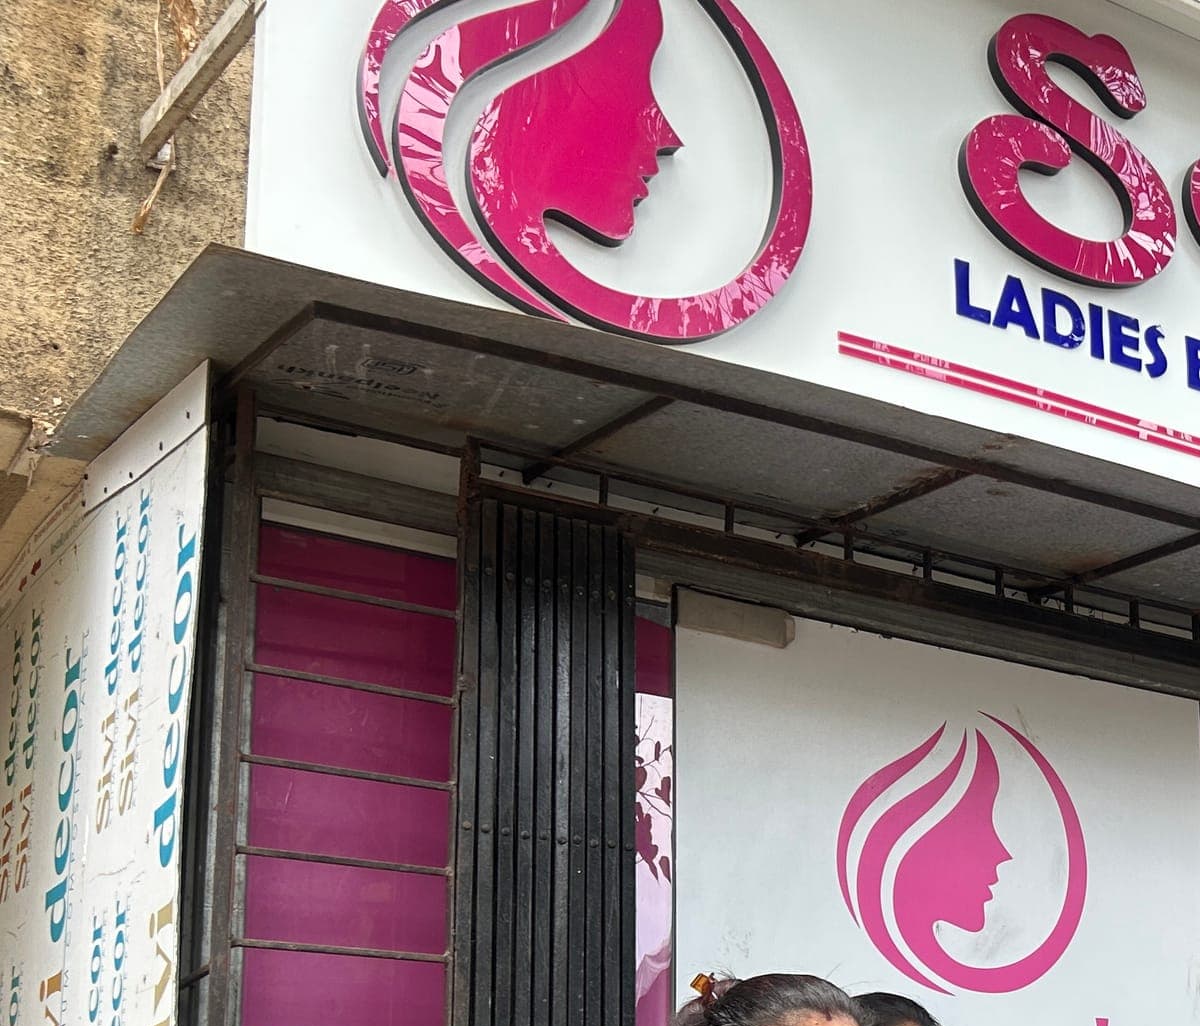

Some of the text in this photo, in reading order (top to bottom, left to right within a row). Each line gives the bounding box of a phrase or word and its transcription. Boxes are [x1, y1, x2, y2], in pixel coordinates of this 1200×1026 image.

[953, 258, 1169, 379] LADIES
[105, 511, 127, 696] decor
[128, 488, 150, 673] decor
[4, 629, 22, 787] decor
[22, 608, 42, 770] decor
[118, 688, 140, 817] Sivi
[154, 522, 197, 868] decor
[15, 783, 32, 893] Sivi
[45, 647, 81, 943] decor
[96, 711, 116, 834] Sivi
